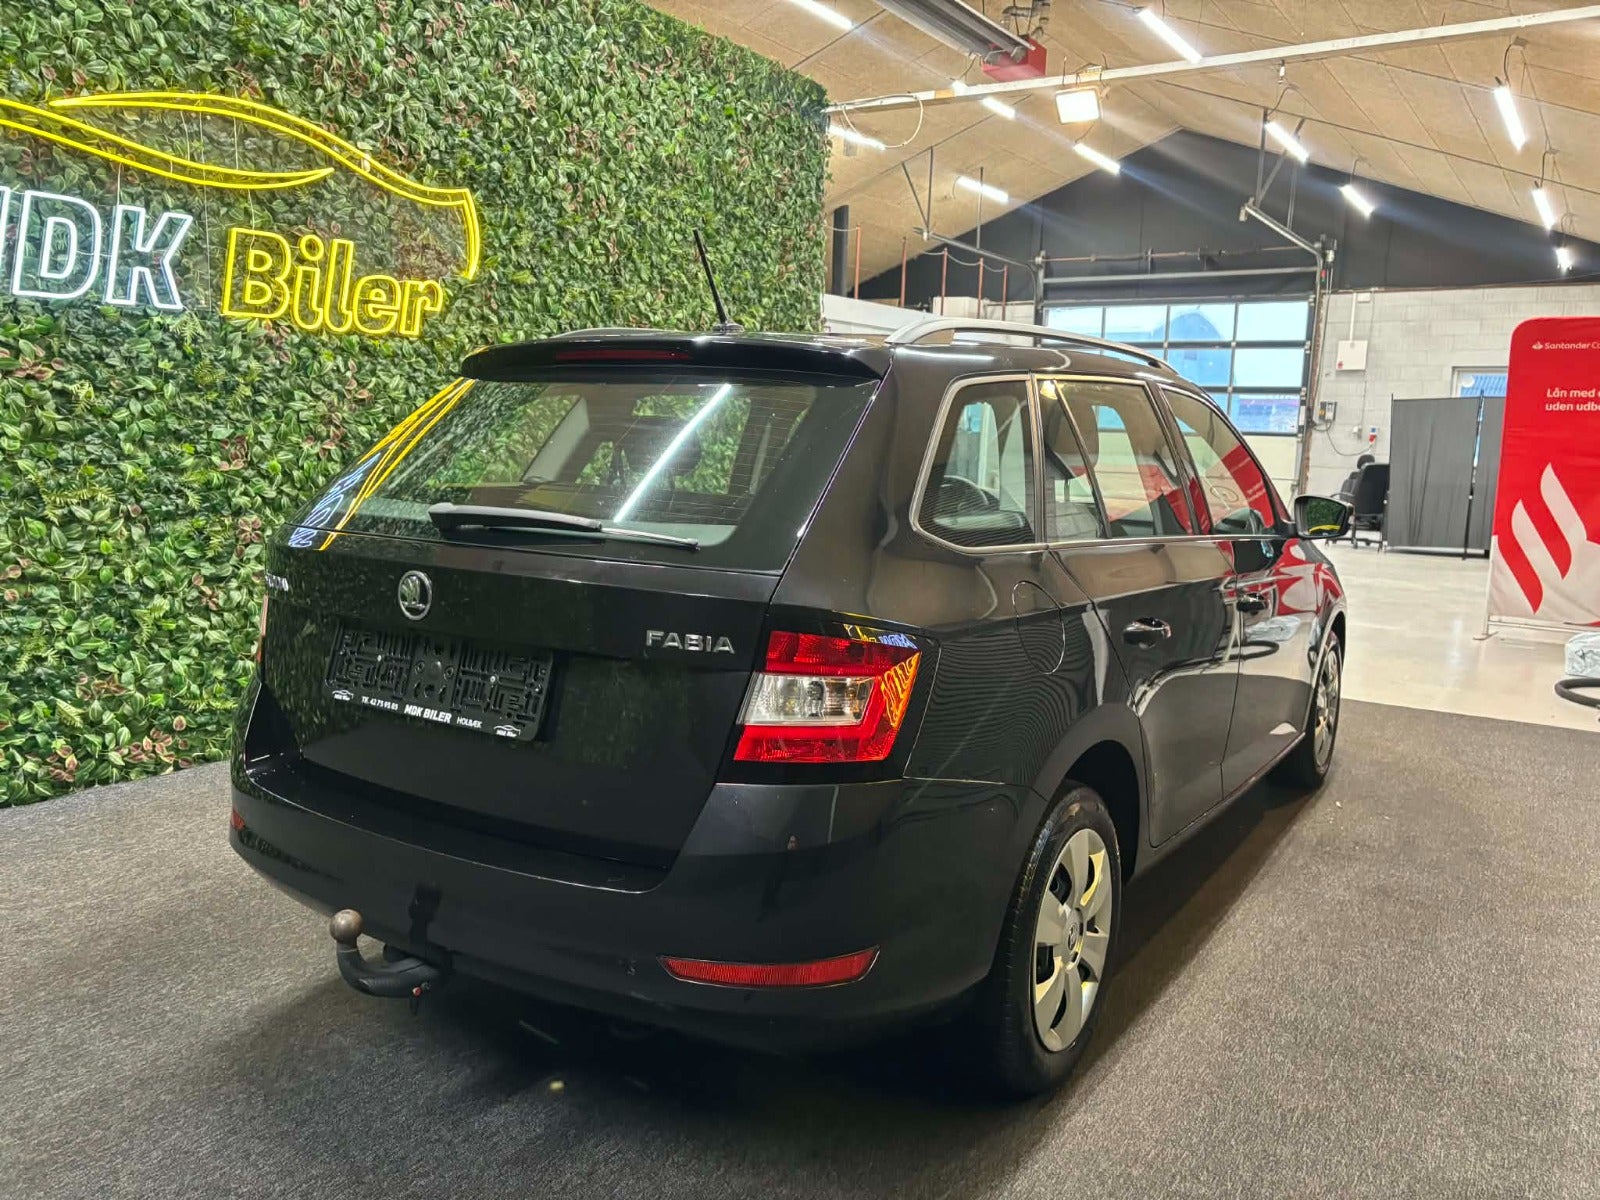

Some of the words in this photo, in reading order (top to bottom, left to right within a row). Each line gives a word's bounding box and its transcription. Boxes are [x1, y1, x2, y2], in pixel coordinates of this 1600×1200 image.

[0, 186, 193, 311] DK
[220, 226, 444, 338] Biler
[1545, 341, 1590, 350] Santander
[1546, 387, 1567, 398] Lån
[1570, 388, 1596, 398] med
[1545, 402, 1573, 411] uden
[645, 629, 735, 655] FABIA
[403, 704, 424, 717] MDK
[422, 708, 452, 724] BILER
